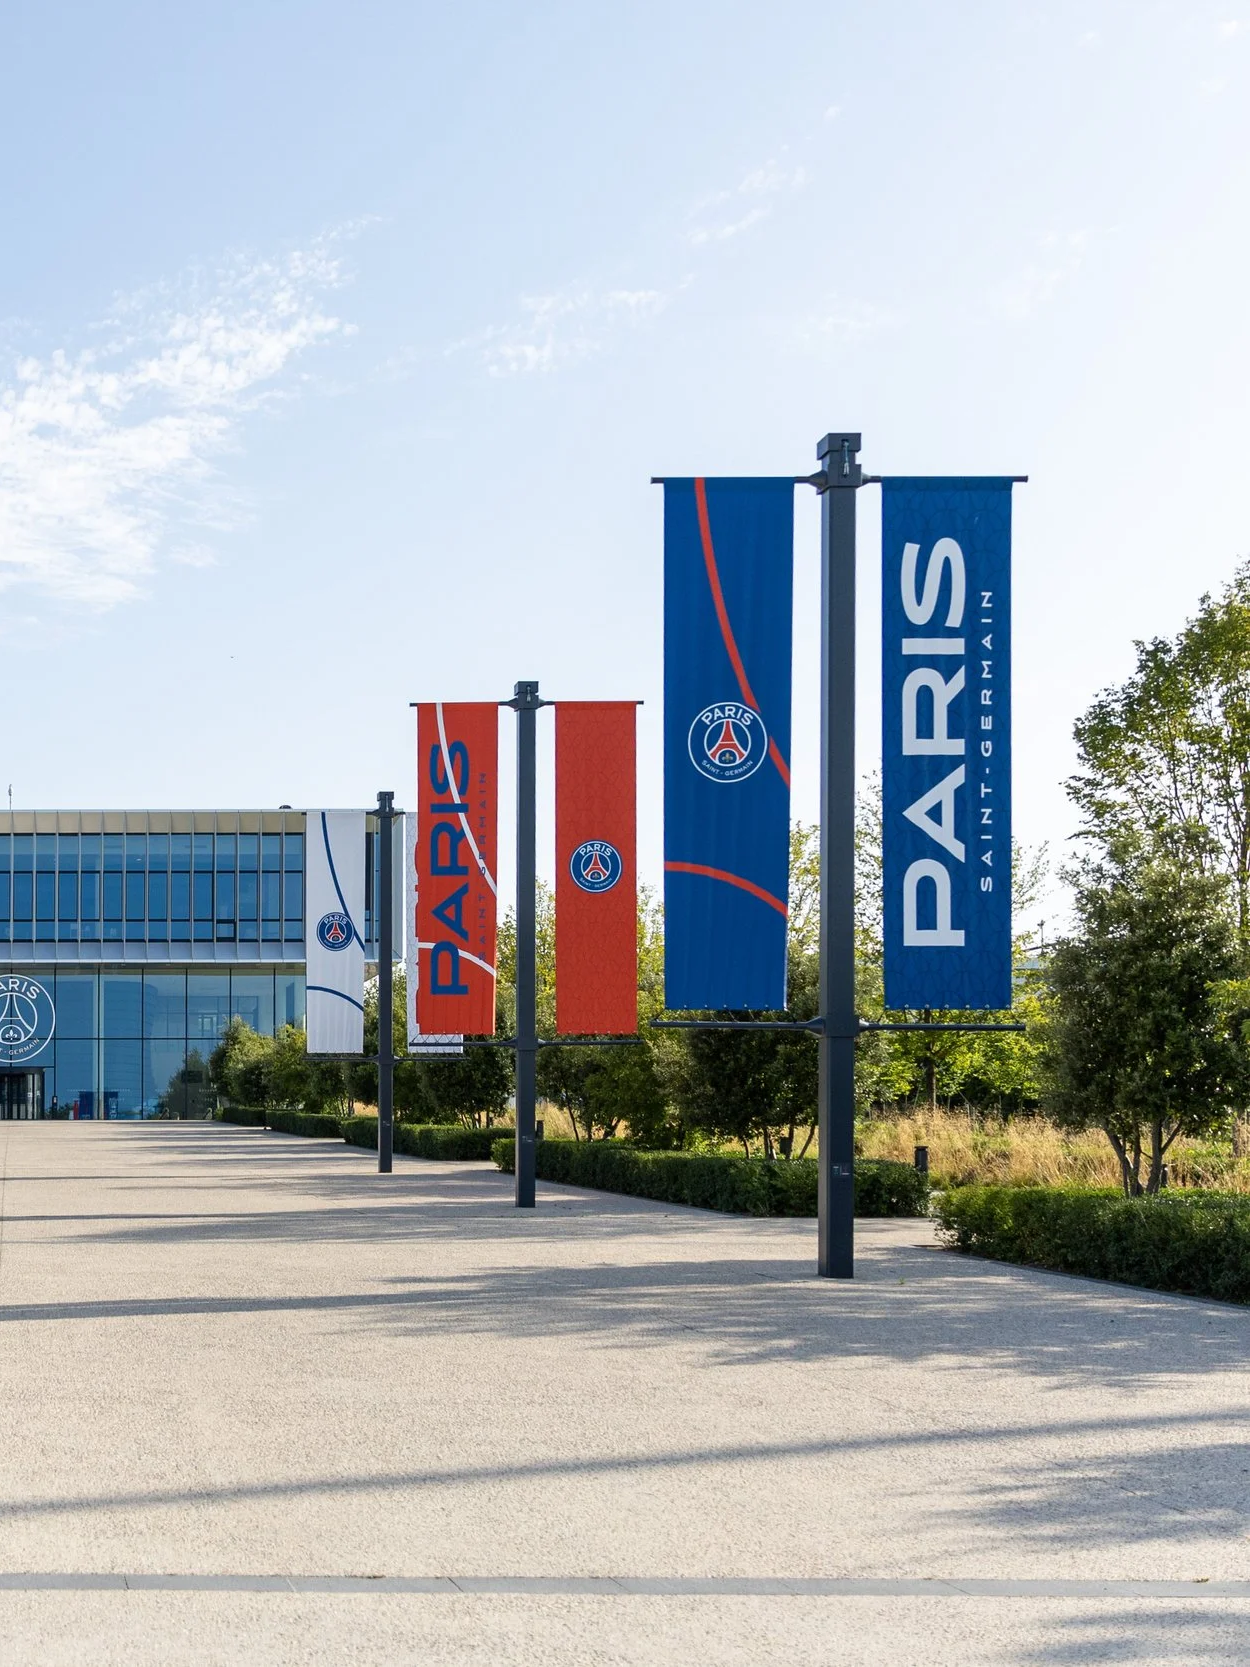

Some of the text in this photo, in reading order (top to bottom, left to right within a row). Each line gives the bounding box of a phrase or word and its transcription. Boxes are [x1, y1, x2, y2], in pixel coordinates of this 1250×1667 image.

[701, 706, 754, 726] PARIS
[900, 537, 966, 947] PARIS
[430, 740, 470, 995] PARIS
[579, 843, 613, 856] PARIS
